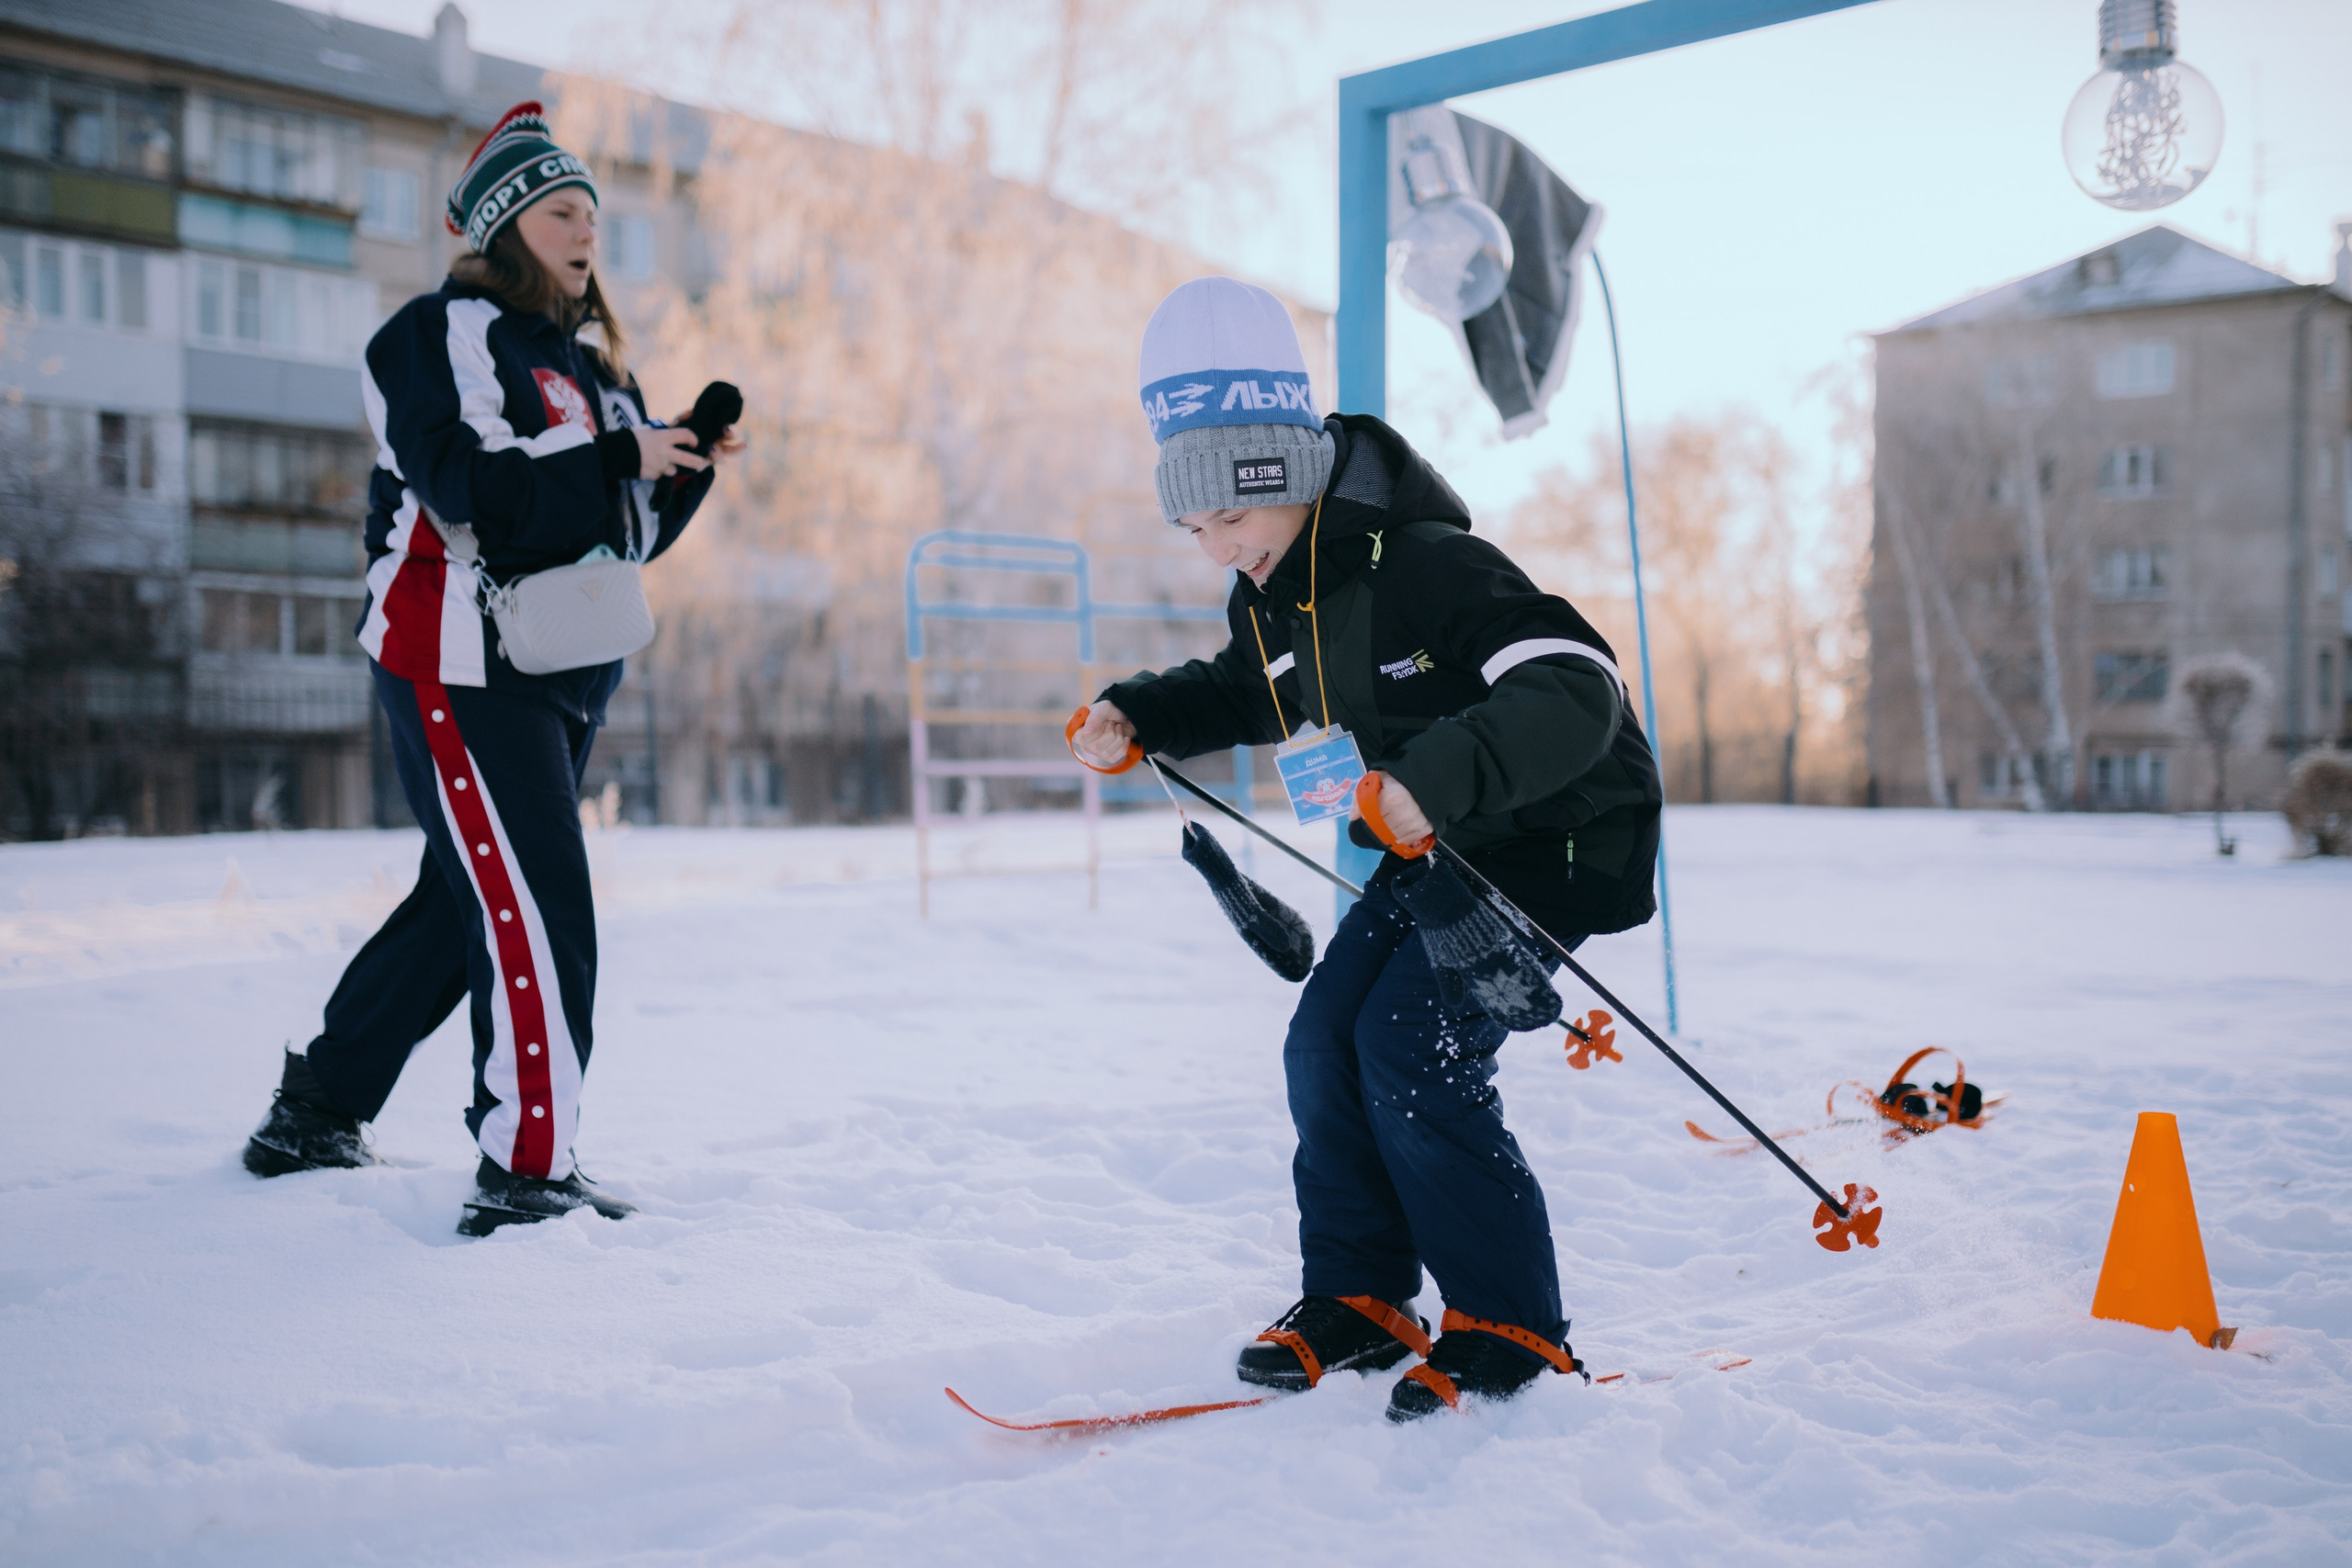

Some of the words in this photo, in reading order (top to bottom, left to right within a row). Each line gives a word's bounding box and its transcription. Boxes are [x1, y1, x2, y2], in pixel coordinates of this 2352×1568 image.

[1238, 467, 1255, 479] NEW
[1257, 465, 1283, 479] STARS
[1238, 479, 1265, 488] AUTHENTIC
[1379, 658, 1414, 674] RUNNING
[1305, 754, 1328, 768] ДИМА
